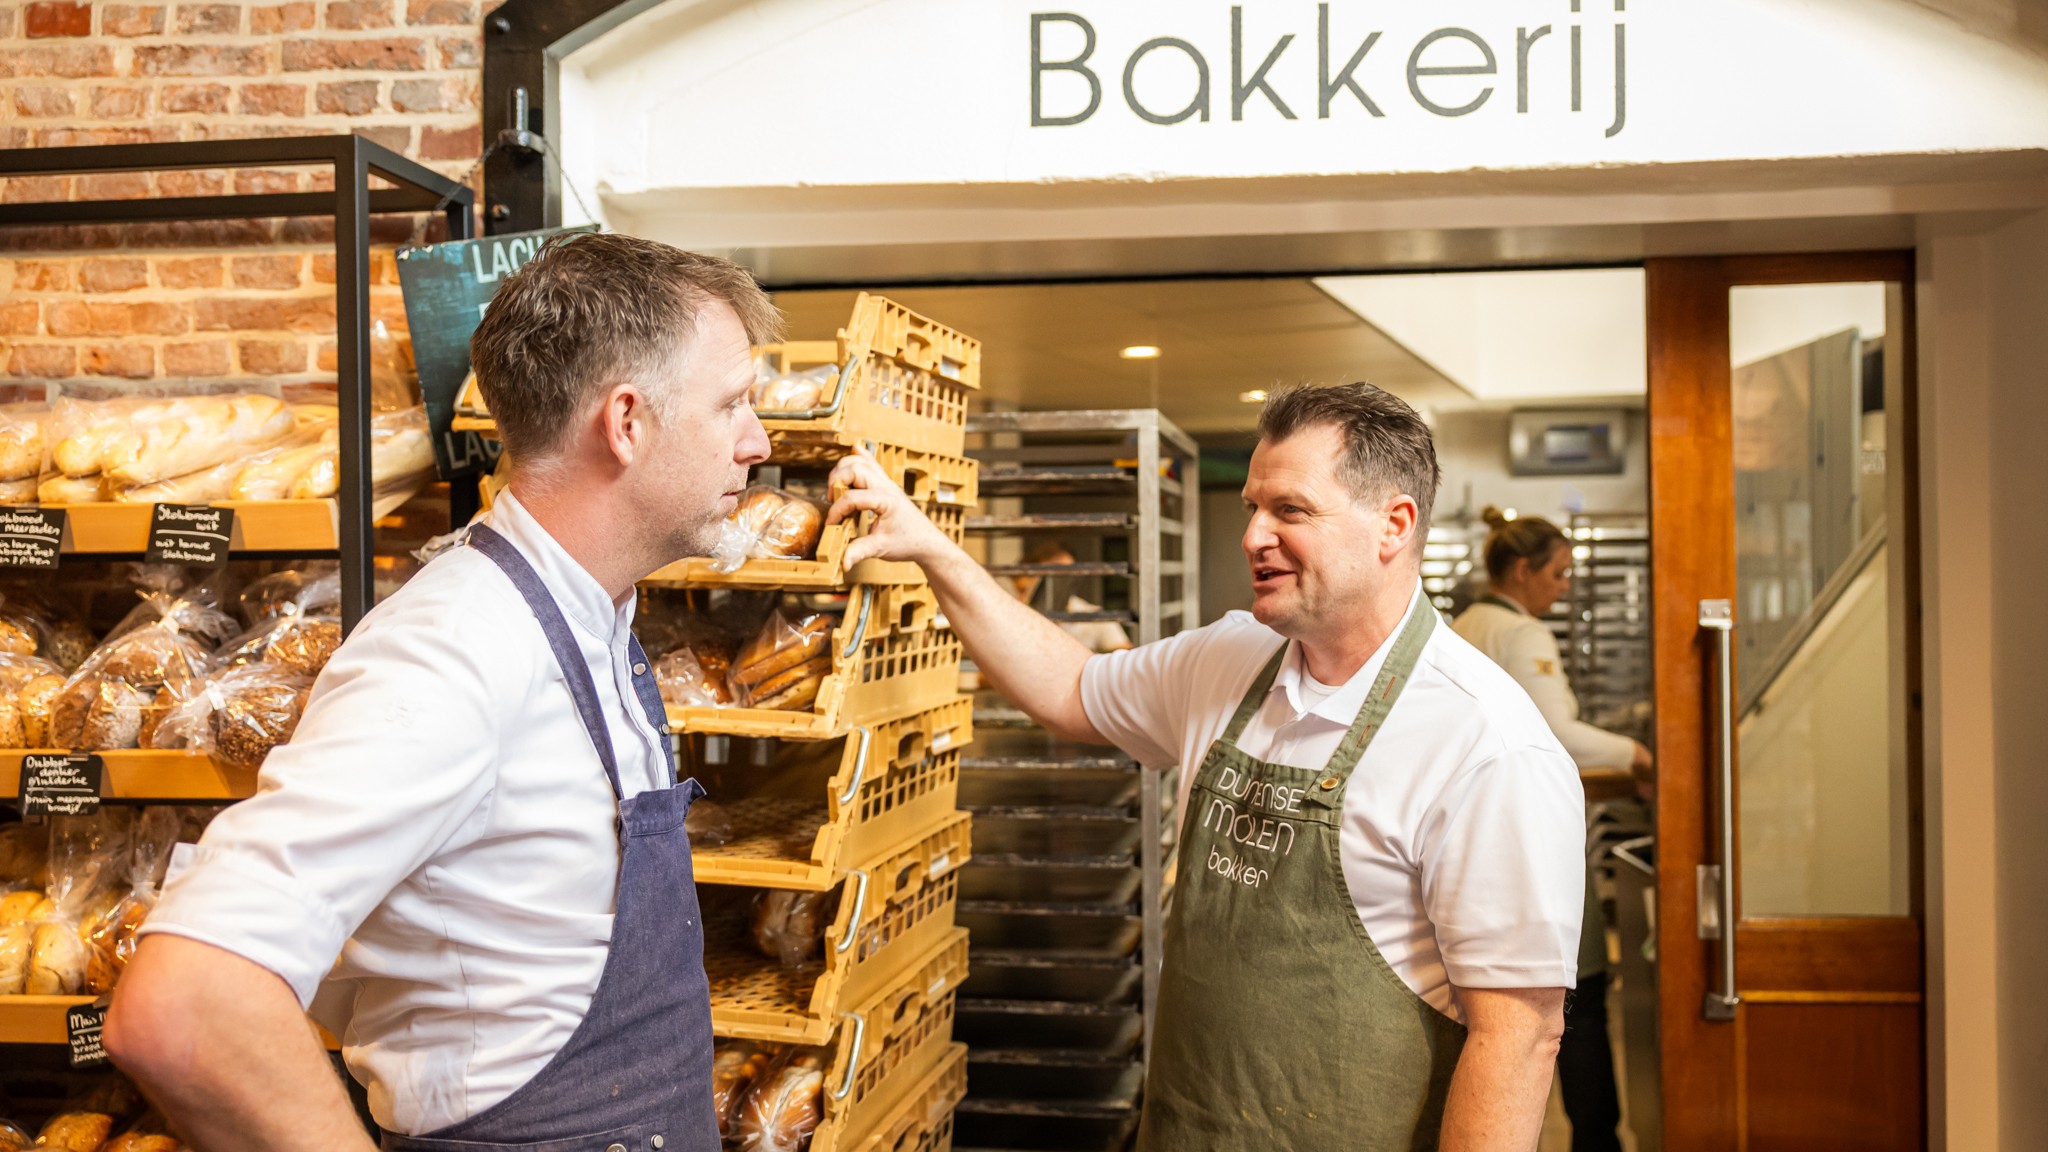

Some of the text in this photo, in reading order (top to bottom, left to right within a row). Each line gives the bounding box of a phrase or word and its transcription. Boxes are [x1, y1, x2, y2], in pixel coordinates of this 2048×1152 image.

[1030, 0, 1626, 138] Bakkerij
[0, 513, 44, 524] okbrood
[158, 504, 220, 521] Stokbrood
[195, 521, 219, 531] wit
[155, 538, 175, 548] wit
[26, 755, 71, 769] Dubbel
[39, 766, 81, 778] donker
[24, 793, 54, 804] bruin
[1203, 799, 1295, 855] MOLEN
[1208, 844, 1268, 888] bakker
[70, 1013, 97, 1030] Mais
[86, 1034, 103, 1044] tar
